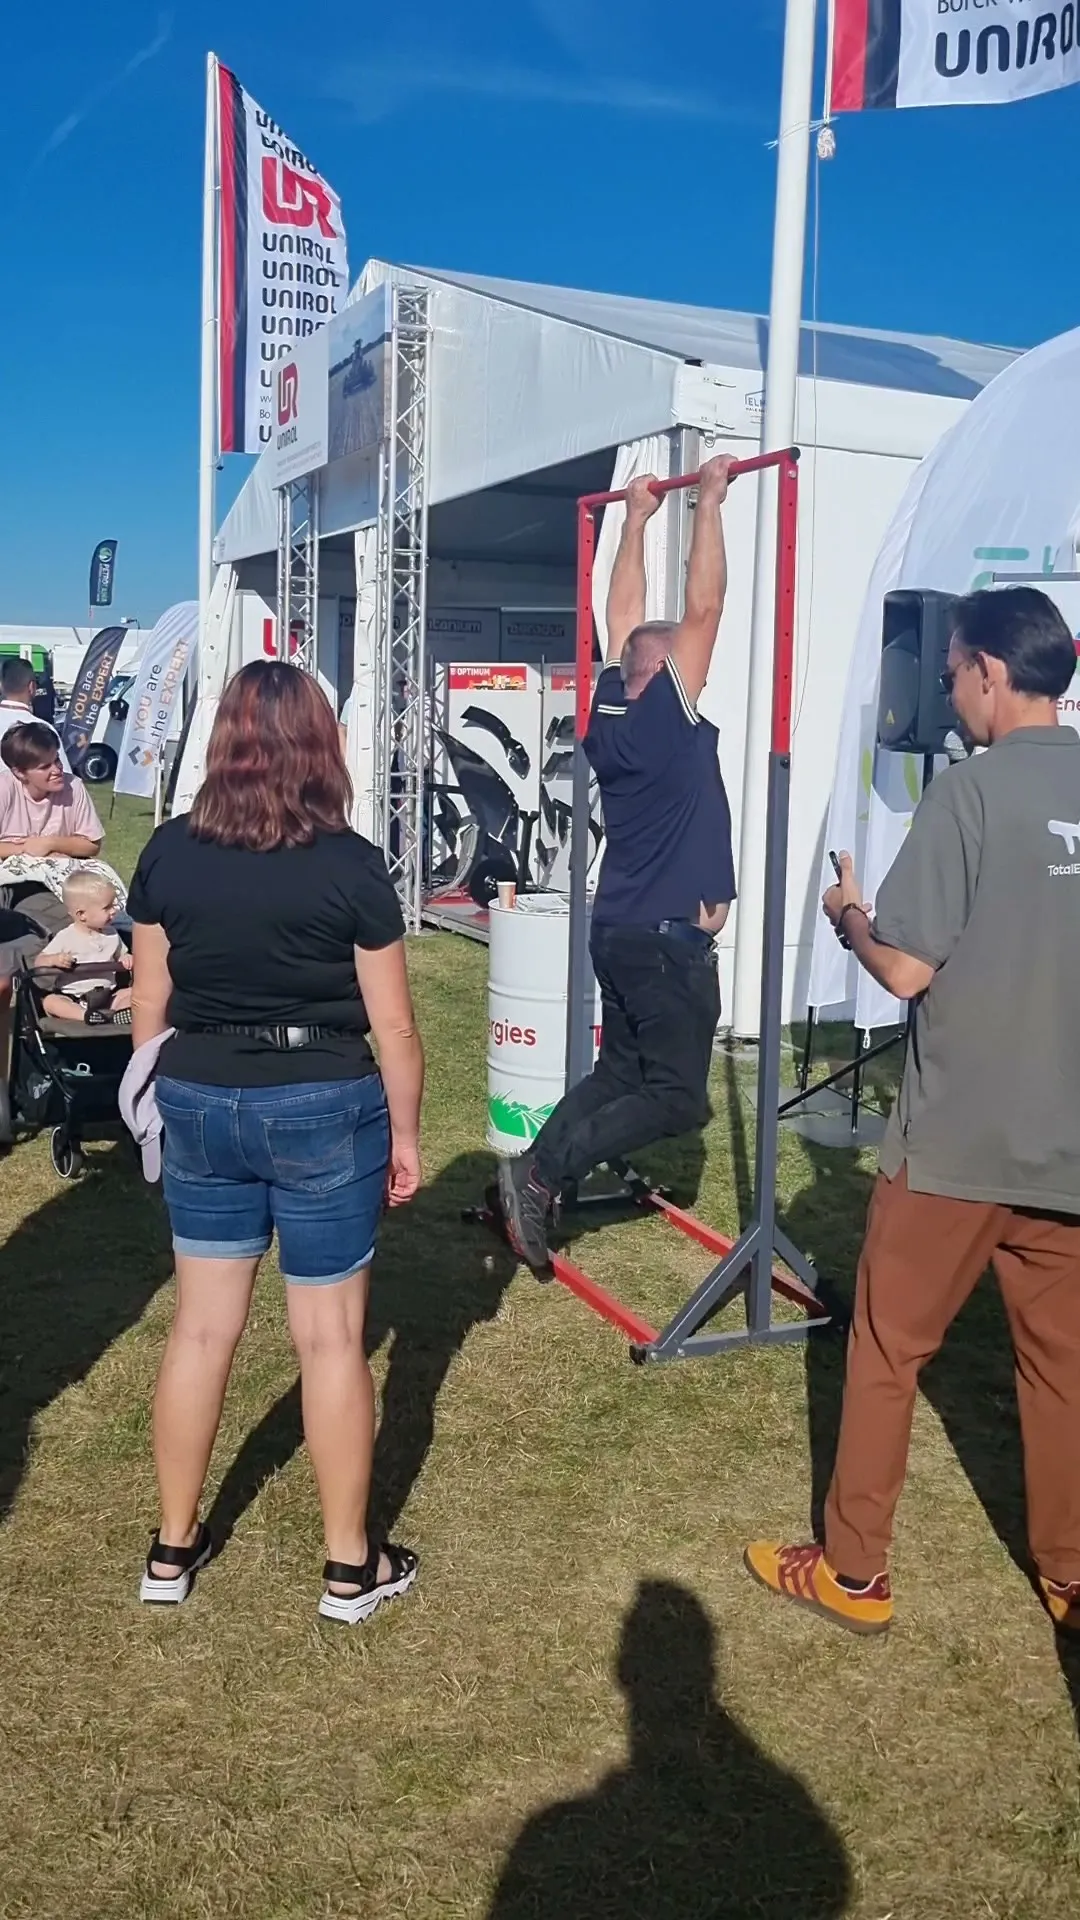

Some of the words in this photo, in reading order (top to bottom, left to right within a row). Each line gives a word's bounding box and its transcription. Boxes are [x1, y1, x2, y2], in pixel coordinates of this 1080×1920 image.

[262, 232, 335, 264] UNIROL
[262, 259, 340, 288] UNIROL
[262, 287, 337, 314] UNIROL
[261, 315, 326, 337] UNIR
[159, 638, 189, 705] EXPERT
[457, 667, 491, 677] OPTIMUM
[72, 693, 88, 720] YOU
[82, 670, 94, 691] are
[85, 703, 99, 725] the
[92, 651, 114, 701] EXPERT
[134, 695, 152, 731] YOU
[147, 664, 162, 691] are
[151, 710, 168, 738] the
